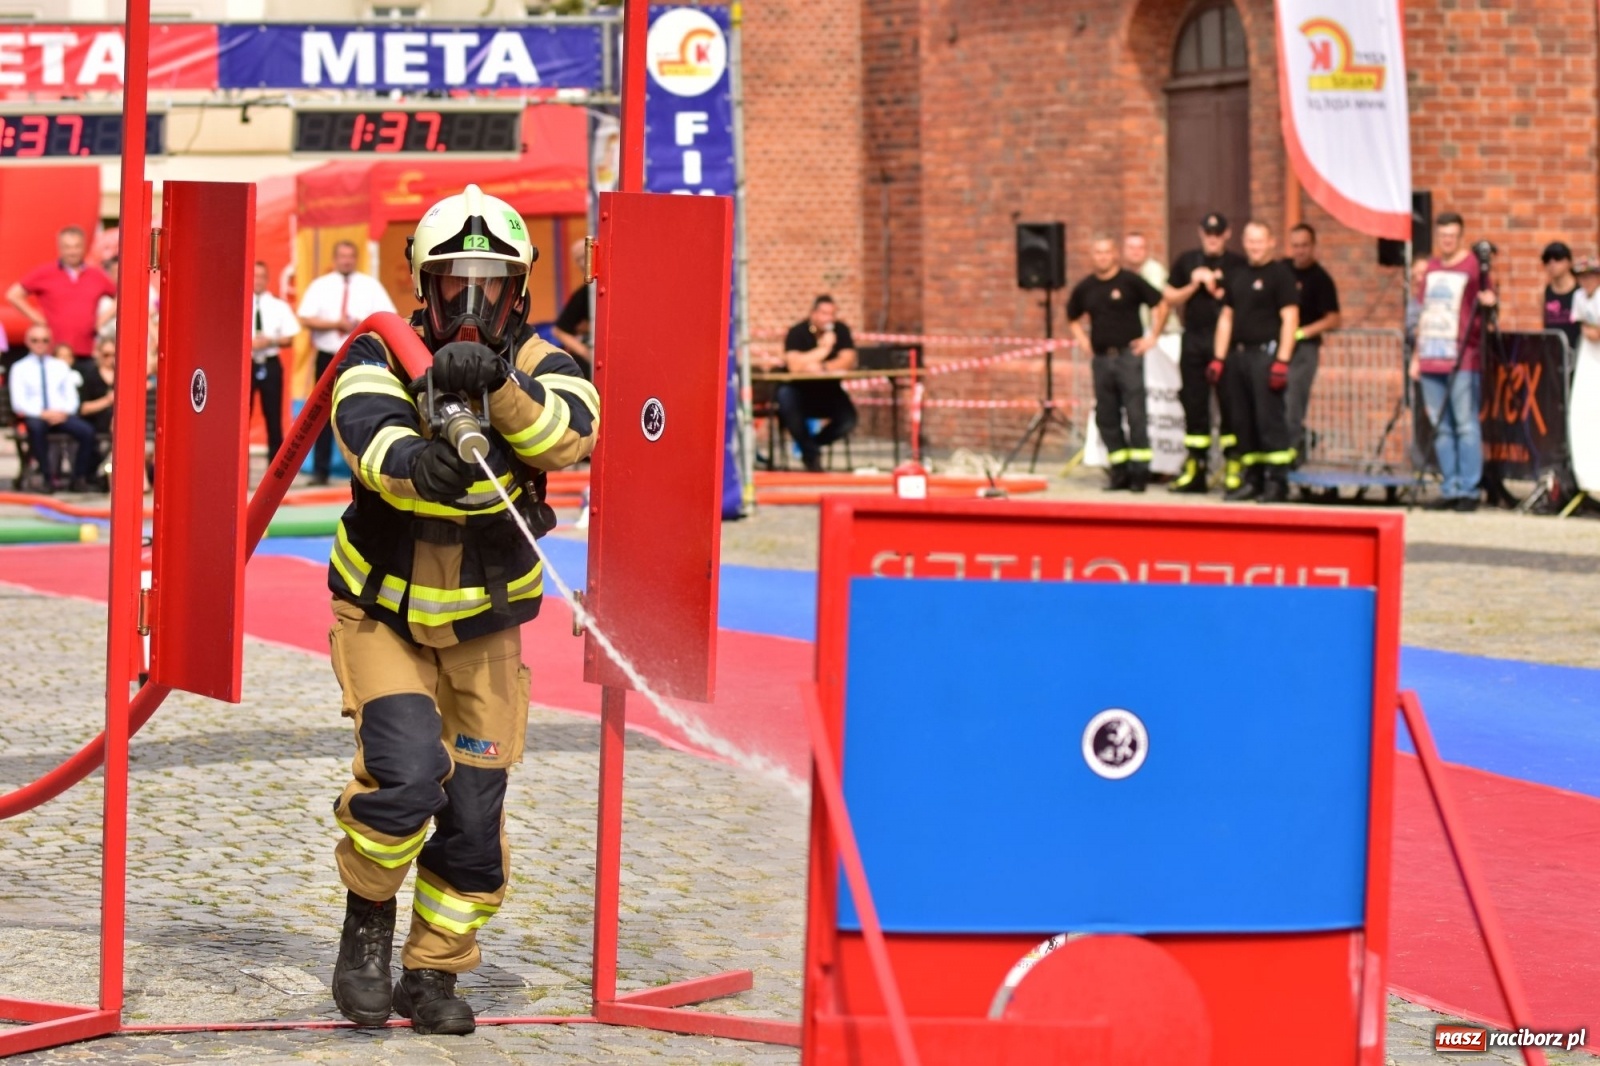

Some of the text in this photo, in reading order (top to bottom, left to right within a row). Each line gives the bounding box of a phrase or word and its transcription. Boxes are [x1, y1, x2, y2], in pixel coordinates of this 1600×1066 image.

[301, 31, 540, 86] META
[670, 111, 716, 197] FI
[508, 218, 522, 231] 18
[468, 236, 486, 249] 12
